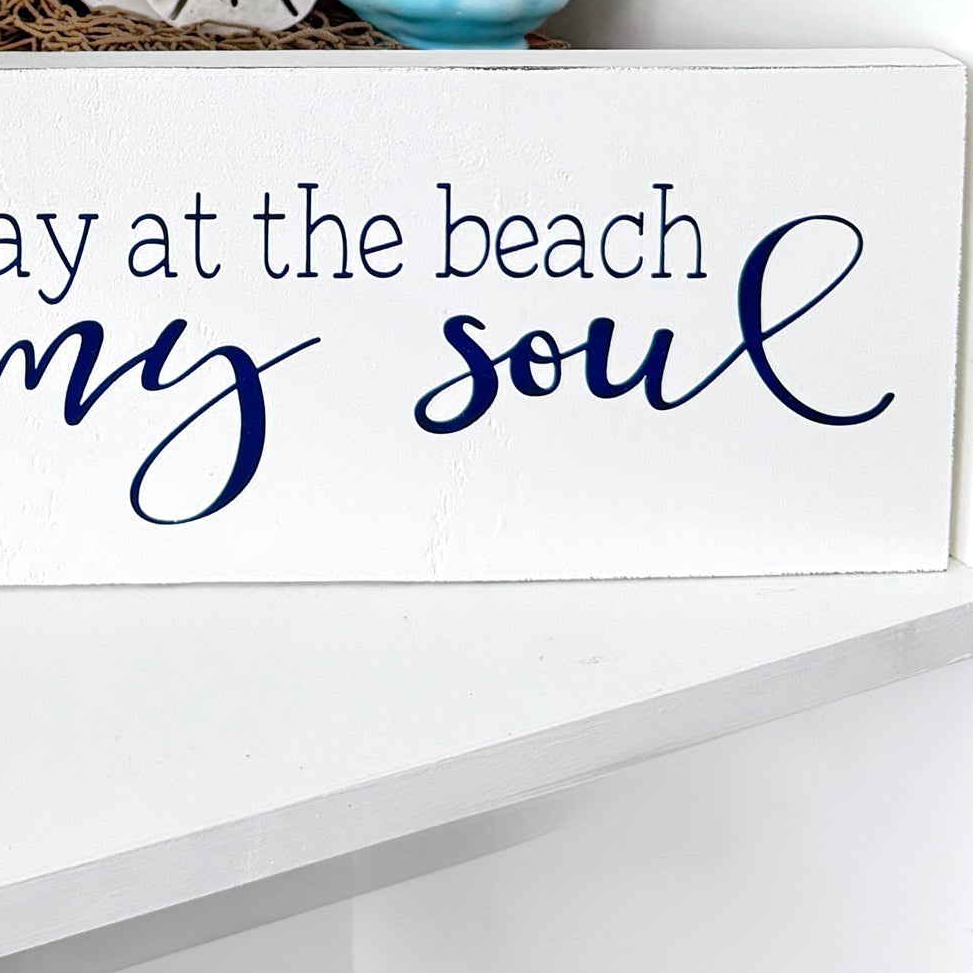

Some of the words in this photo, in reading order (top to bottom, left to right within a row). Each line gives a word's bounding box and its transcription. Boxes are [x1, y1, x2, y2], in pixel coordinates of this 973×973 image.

[127, 191, 221, 280] at
[252, 182, 404, 280] the
[435, 182, 708, 280] beach
[413, 214, 896, 435] soul
